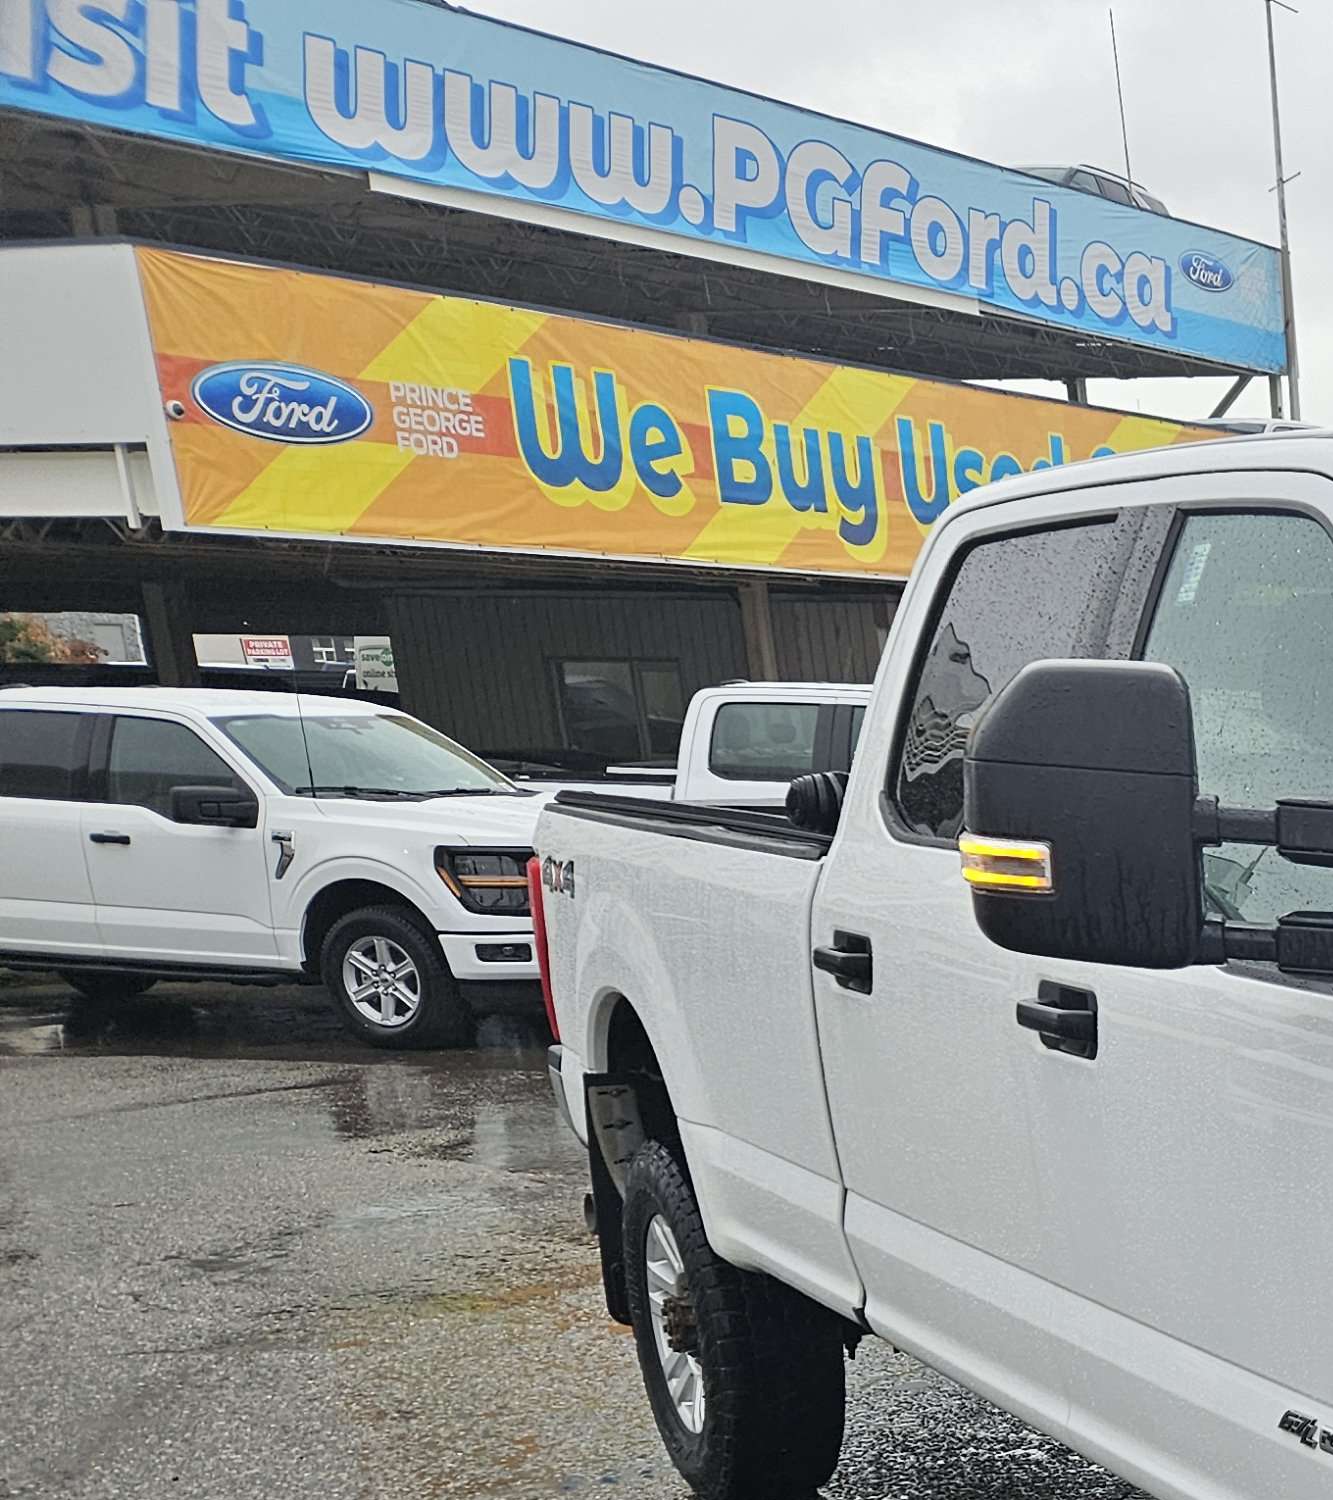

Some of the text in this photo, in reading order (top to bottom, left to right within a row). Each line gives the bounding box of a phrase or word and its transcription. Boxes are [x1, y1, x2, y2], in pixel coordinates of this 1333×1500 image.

[303, 32, 1172, 331] www.PGford.ca
[1190, 255, 1223, 287] Ford
[232, 372, 338, 433] Ford
[389, 381, 474, 413] PRINCE
[393, 406, 485, 438] GEORGE
[397, 431, 459, 459] FORD
[508, 355, 689, 501] We
[706, 386, 880, 547] Buy
[248, 640, 284, 648] PRIVATE
